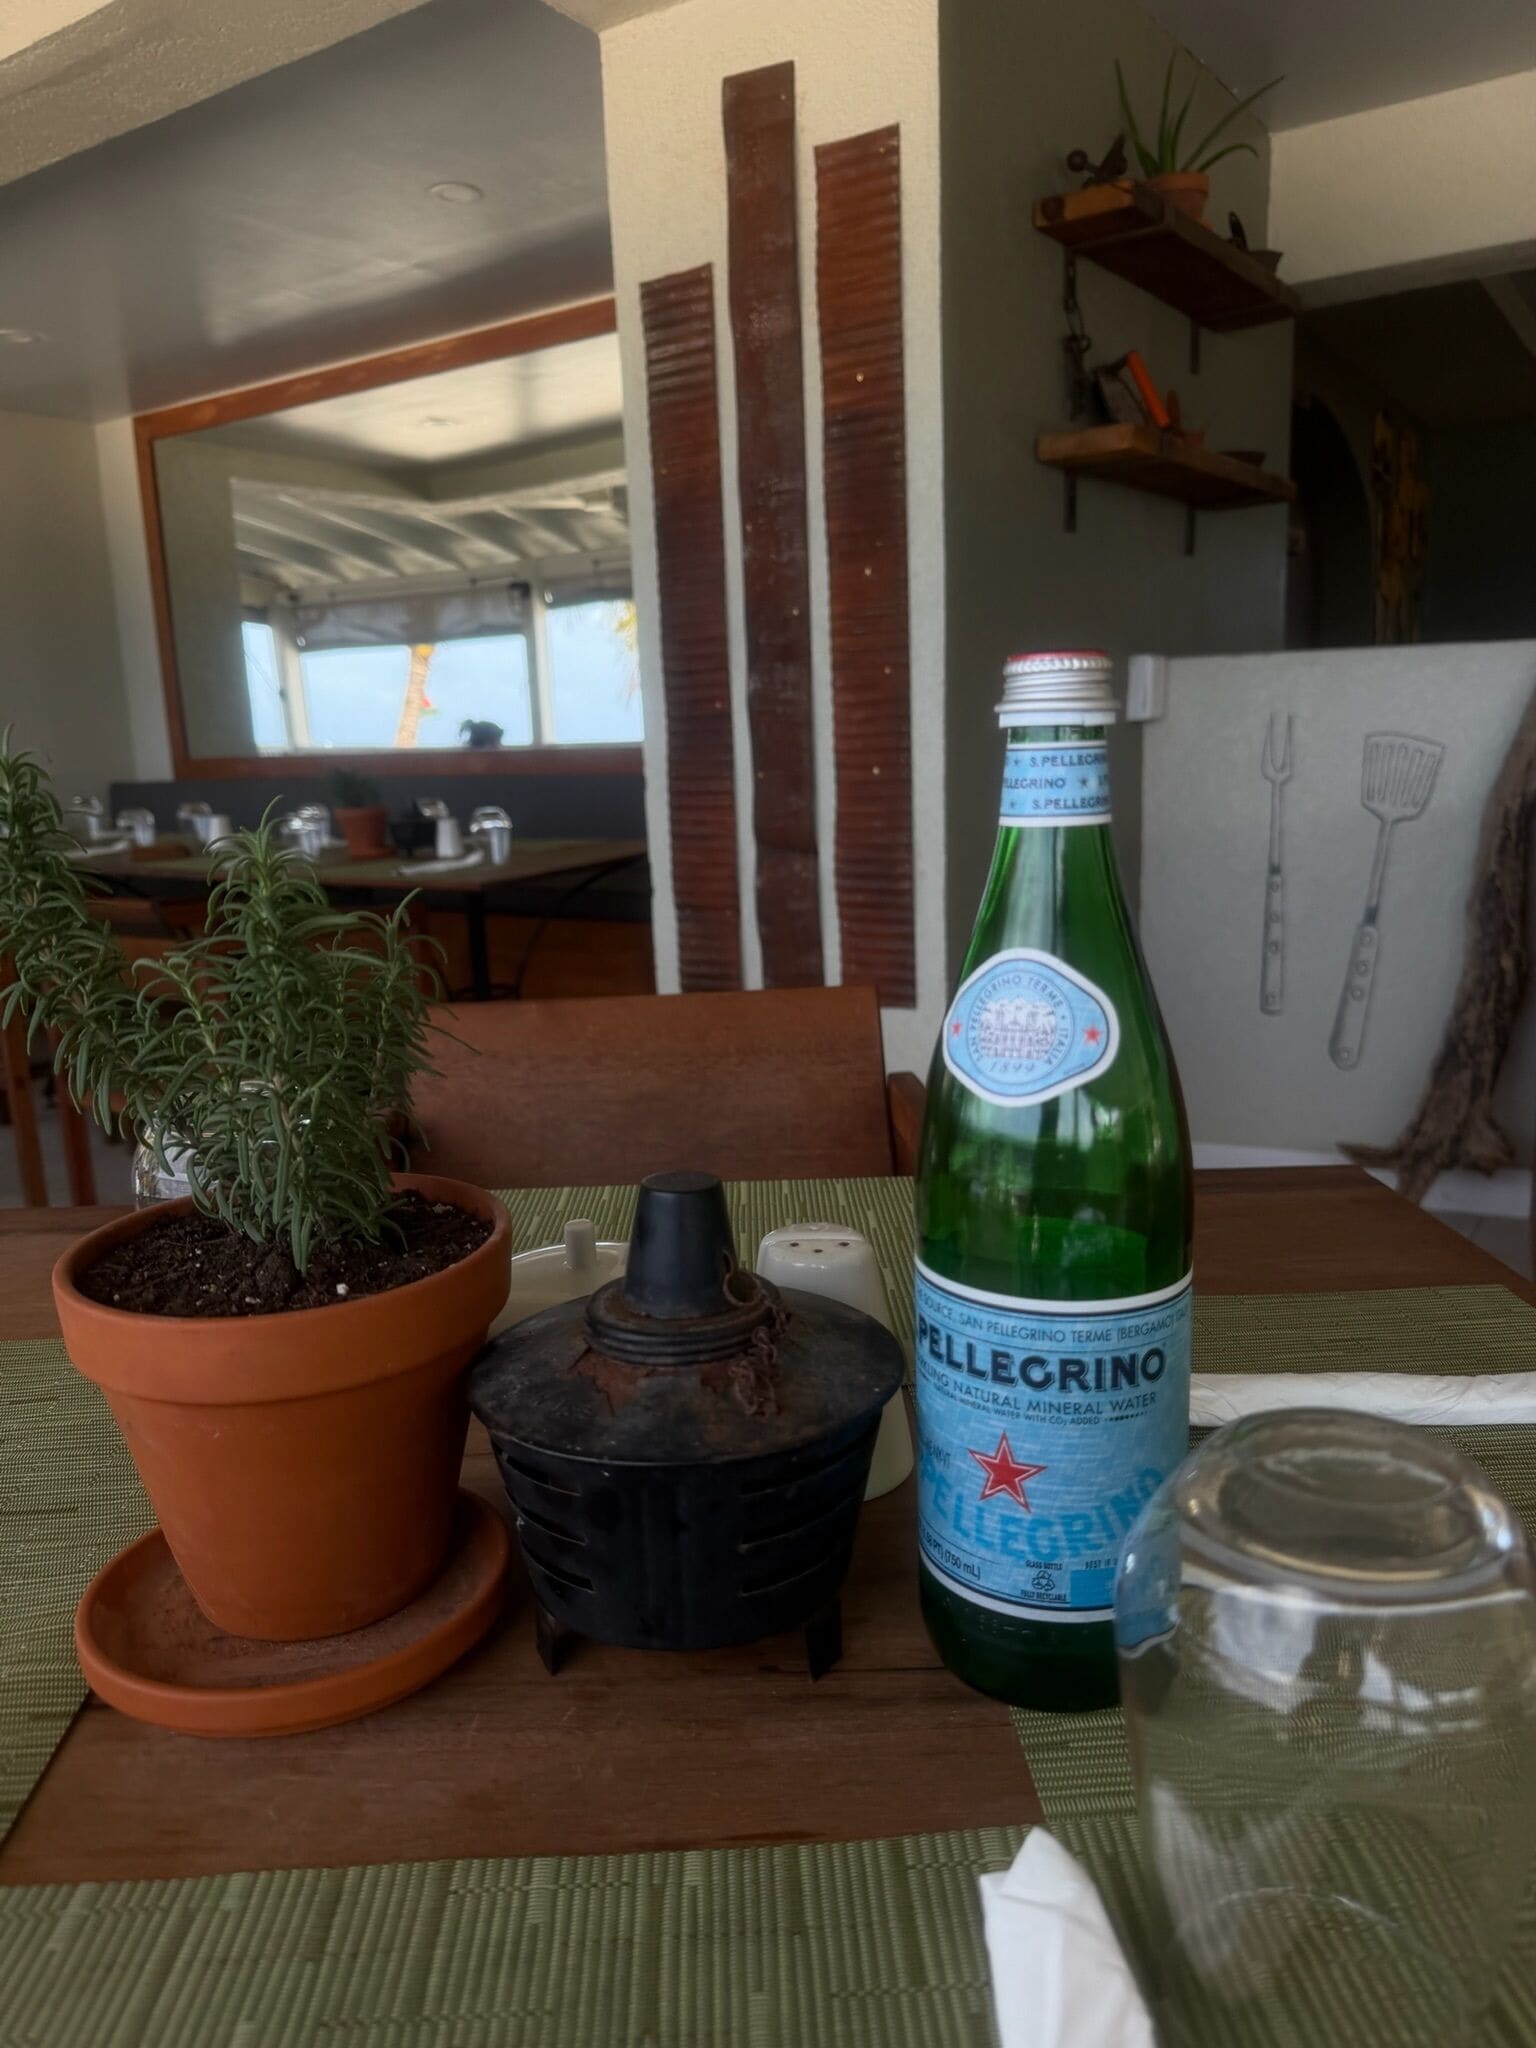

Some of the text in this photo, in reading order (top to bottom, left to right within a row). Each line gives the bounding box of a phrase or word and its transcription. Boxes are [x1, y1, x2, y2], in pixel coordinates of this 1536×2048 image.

[970, 974, 1022, 1031] PELLEGRINO
[1028, 976, 1064, 1008] TERME
[959, 1312, 983, 1331] SAN
[986, 1318, 1066, 1343] PELLEGRINO
[1071, 1328, 1112, 1344] TERME
[918, 1312, 1167, 1393] PELLEGRINO
[953, 1380, 1021, 1411] NATURAL
[1026, 1400, 1103, 1416] MINERAL
[1110, 1391, 1157, 1413] WATER
[993, 1407, 1021, 1420] WATER
[1024, 1412, 1046, 1424] WITH
[1068, 1416, 1100, 1426] ADDED
[963, 1562, 982, 1582] mL)
[1025, 1559, 1043, 1570] GLASS
